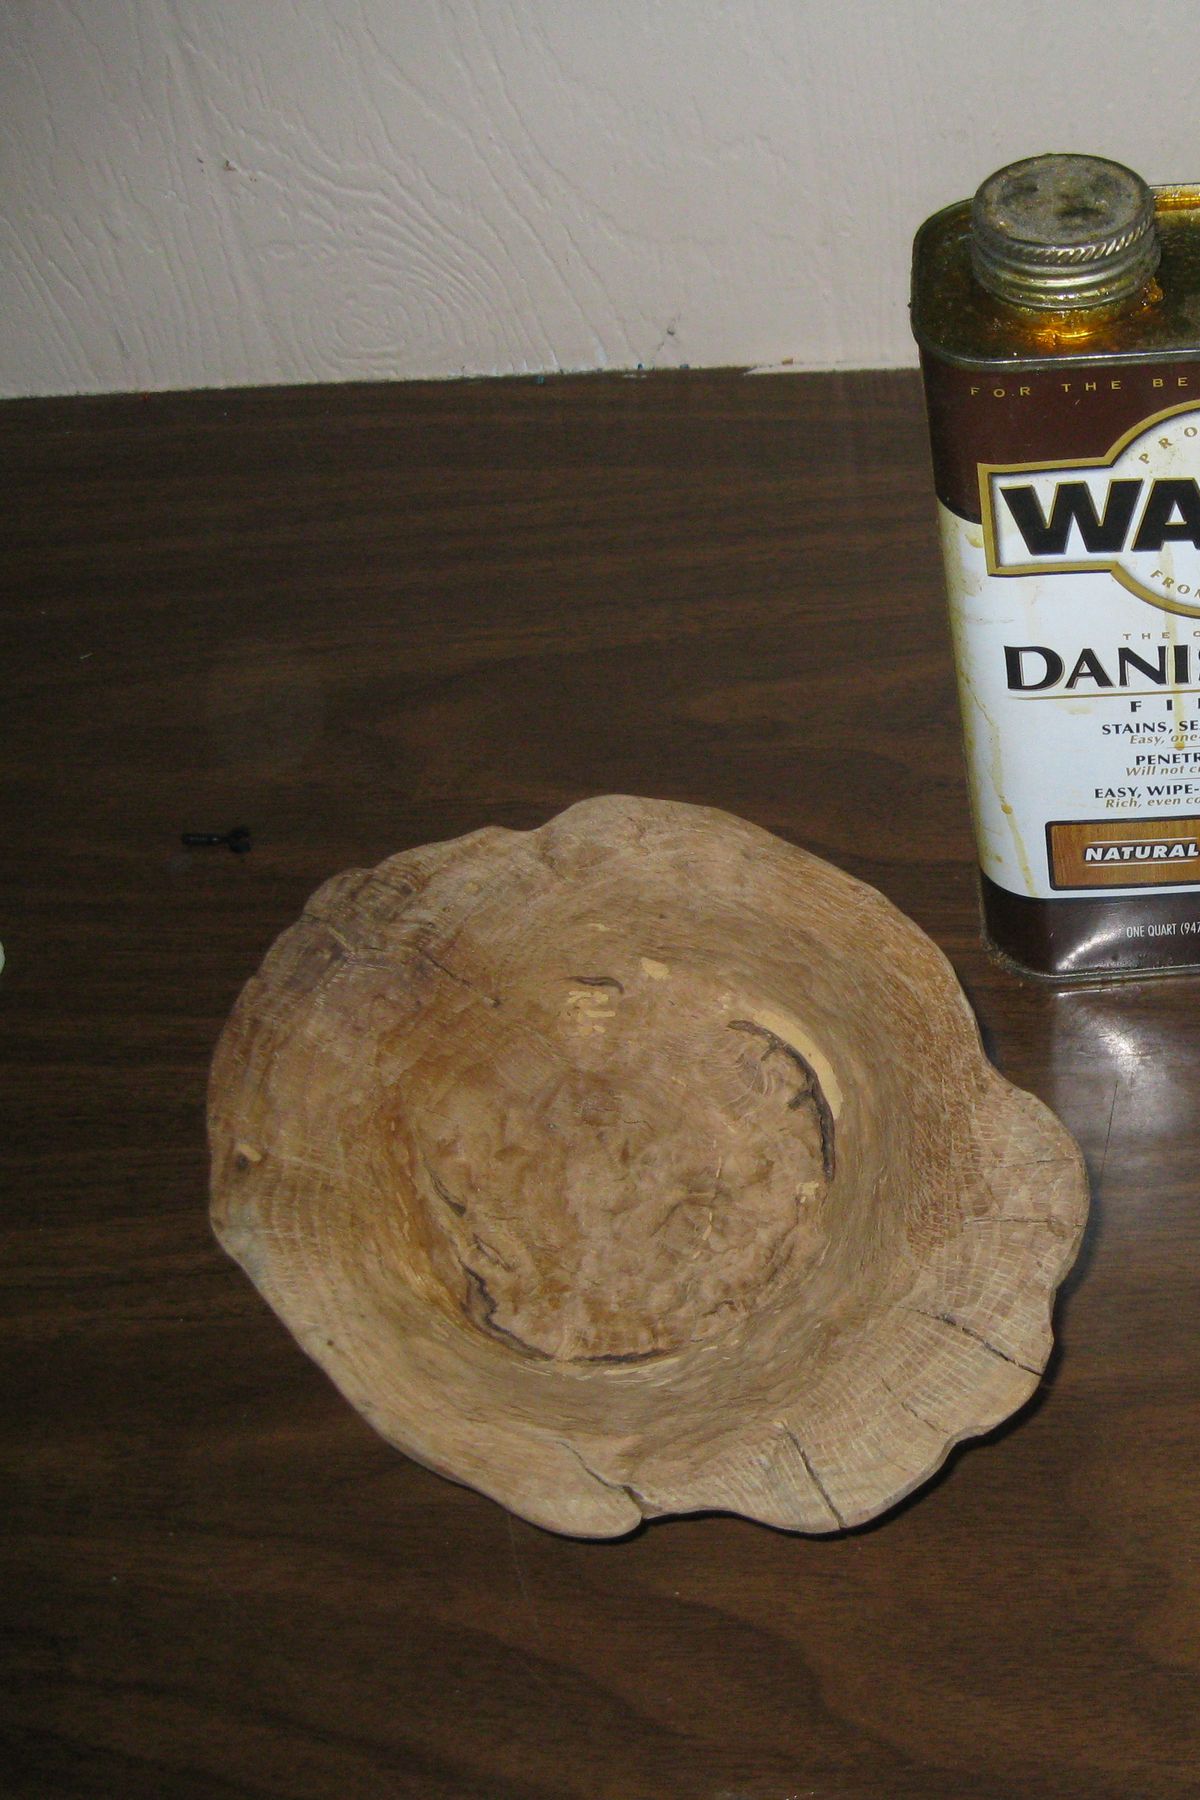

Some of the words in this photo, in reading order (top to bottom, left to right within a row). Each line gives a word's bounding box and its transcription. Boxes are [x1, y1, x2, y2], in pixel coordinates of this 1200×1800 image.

[970, 385, 1031, 398] FOR
[1061, 380, 1121, 393] THE
[1123, 631, 1170, 641] THE
[1101, 720, 1173, 735] STAINS,
[1130, 734, 1165, 746] Easy,
[1126, 766, 1157, 777] Will
[1160, 765, 1185, 775] not
[1095, 786, 1142, 799] EASY,
[1105, 797, 1142, 809] Rich,
[1147, 798, 1181, 807] even
[1084, 842, 1200, 862] NATURAL
[1126, 925, 1145, 938] ONE
[1147, 922, 1177, 938] QUART
